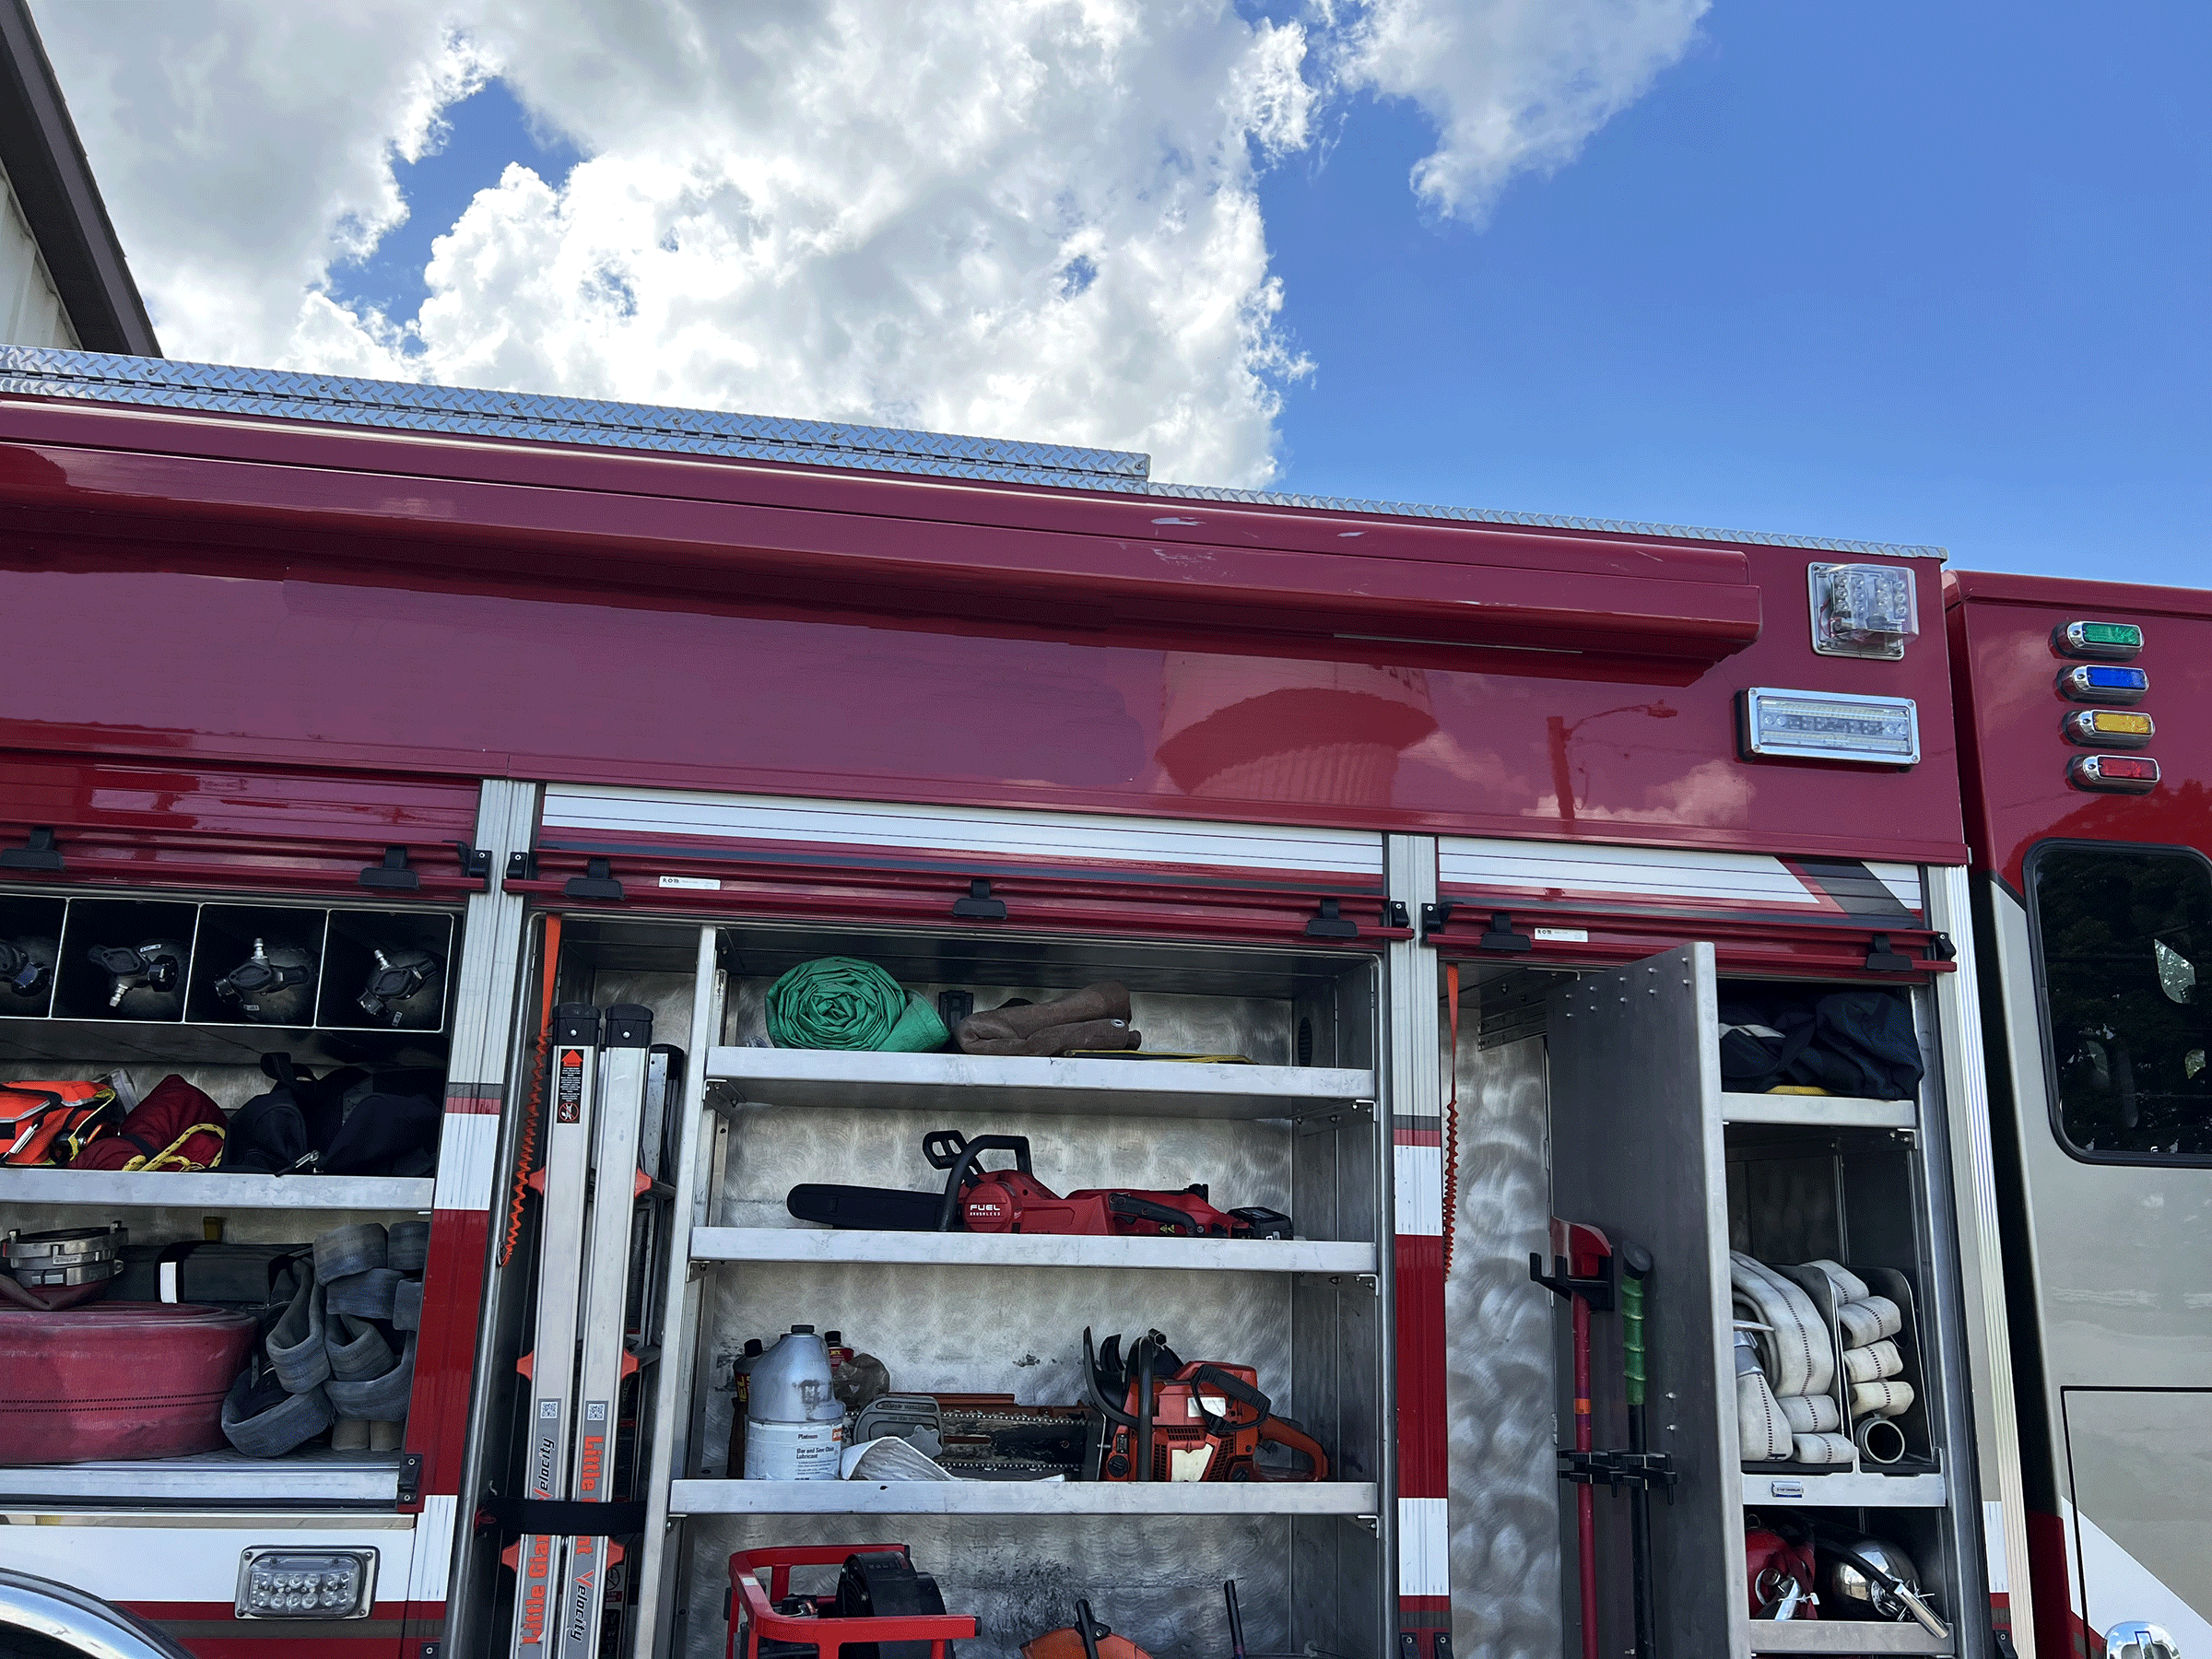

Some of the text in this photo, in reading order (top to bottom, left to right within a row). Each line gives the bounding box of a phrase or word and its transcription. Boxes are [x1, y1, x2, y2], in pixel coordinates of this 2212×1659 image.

[533, 1437, 555, 1500] Velocity
[581, 1435, 605, 1491] Little
[521, 1584, 546, 1644] Little
[570, 1569, 594, 1641] Velocity
